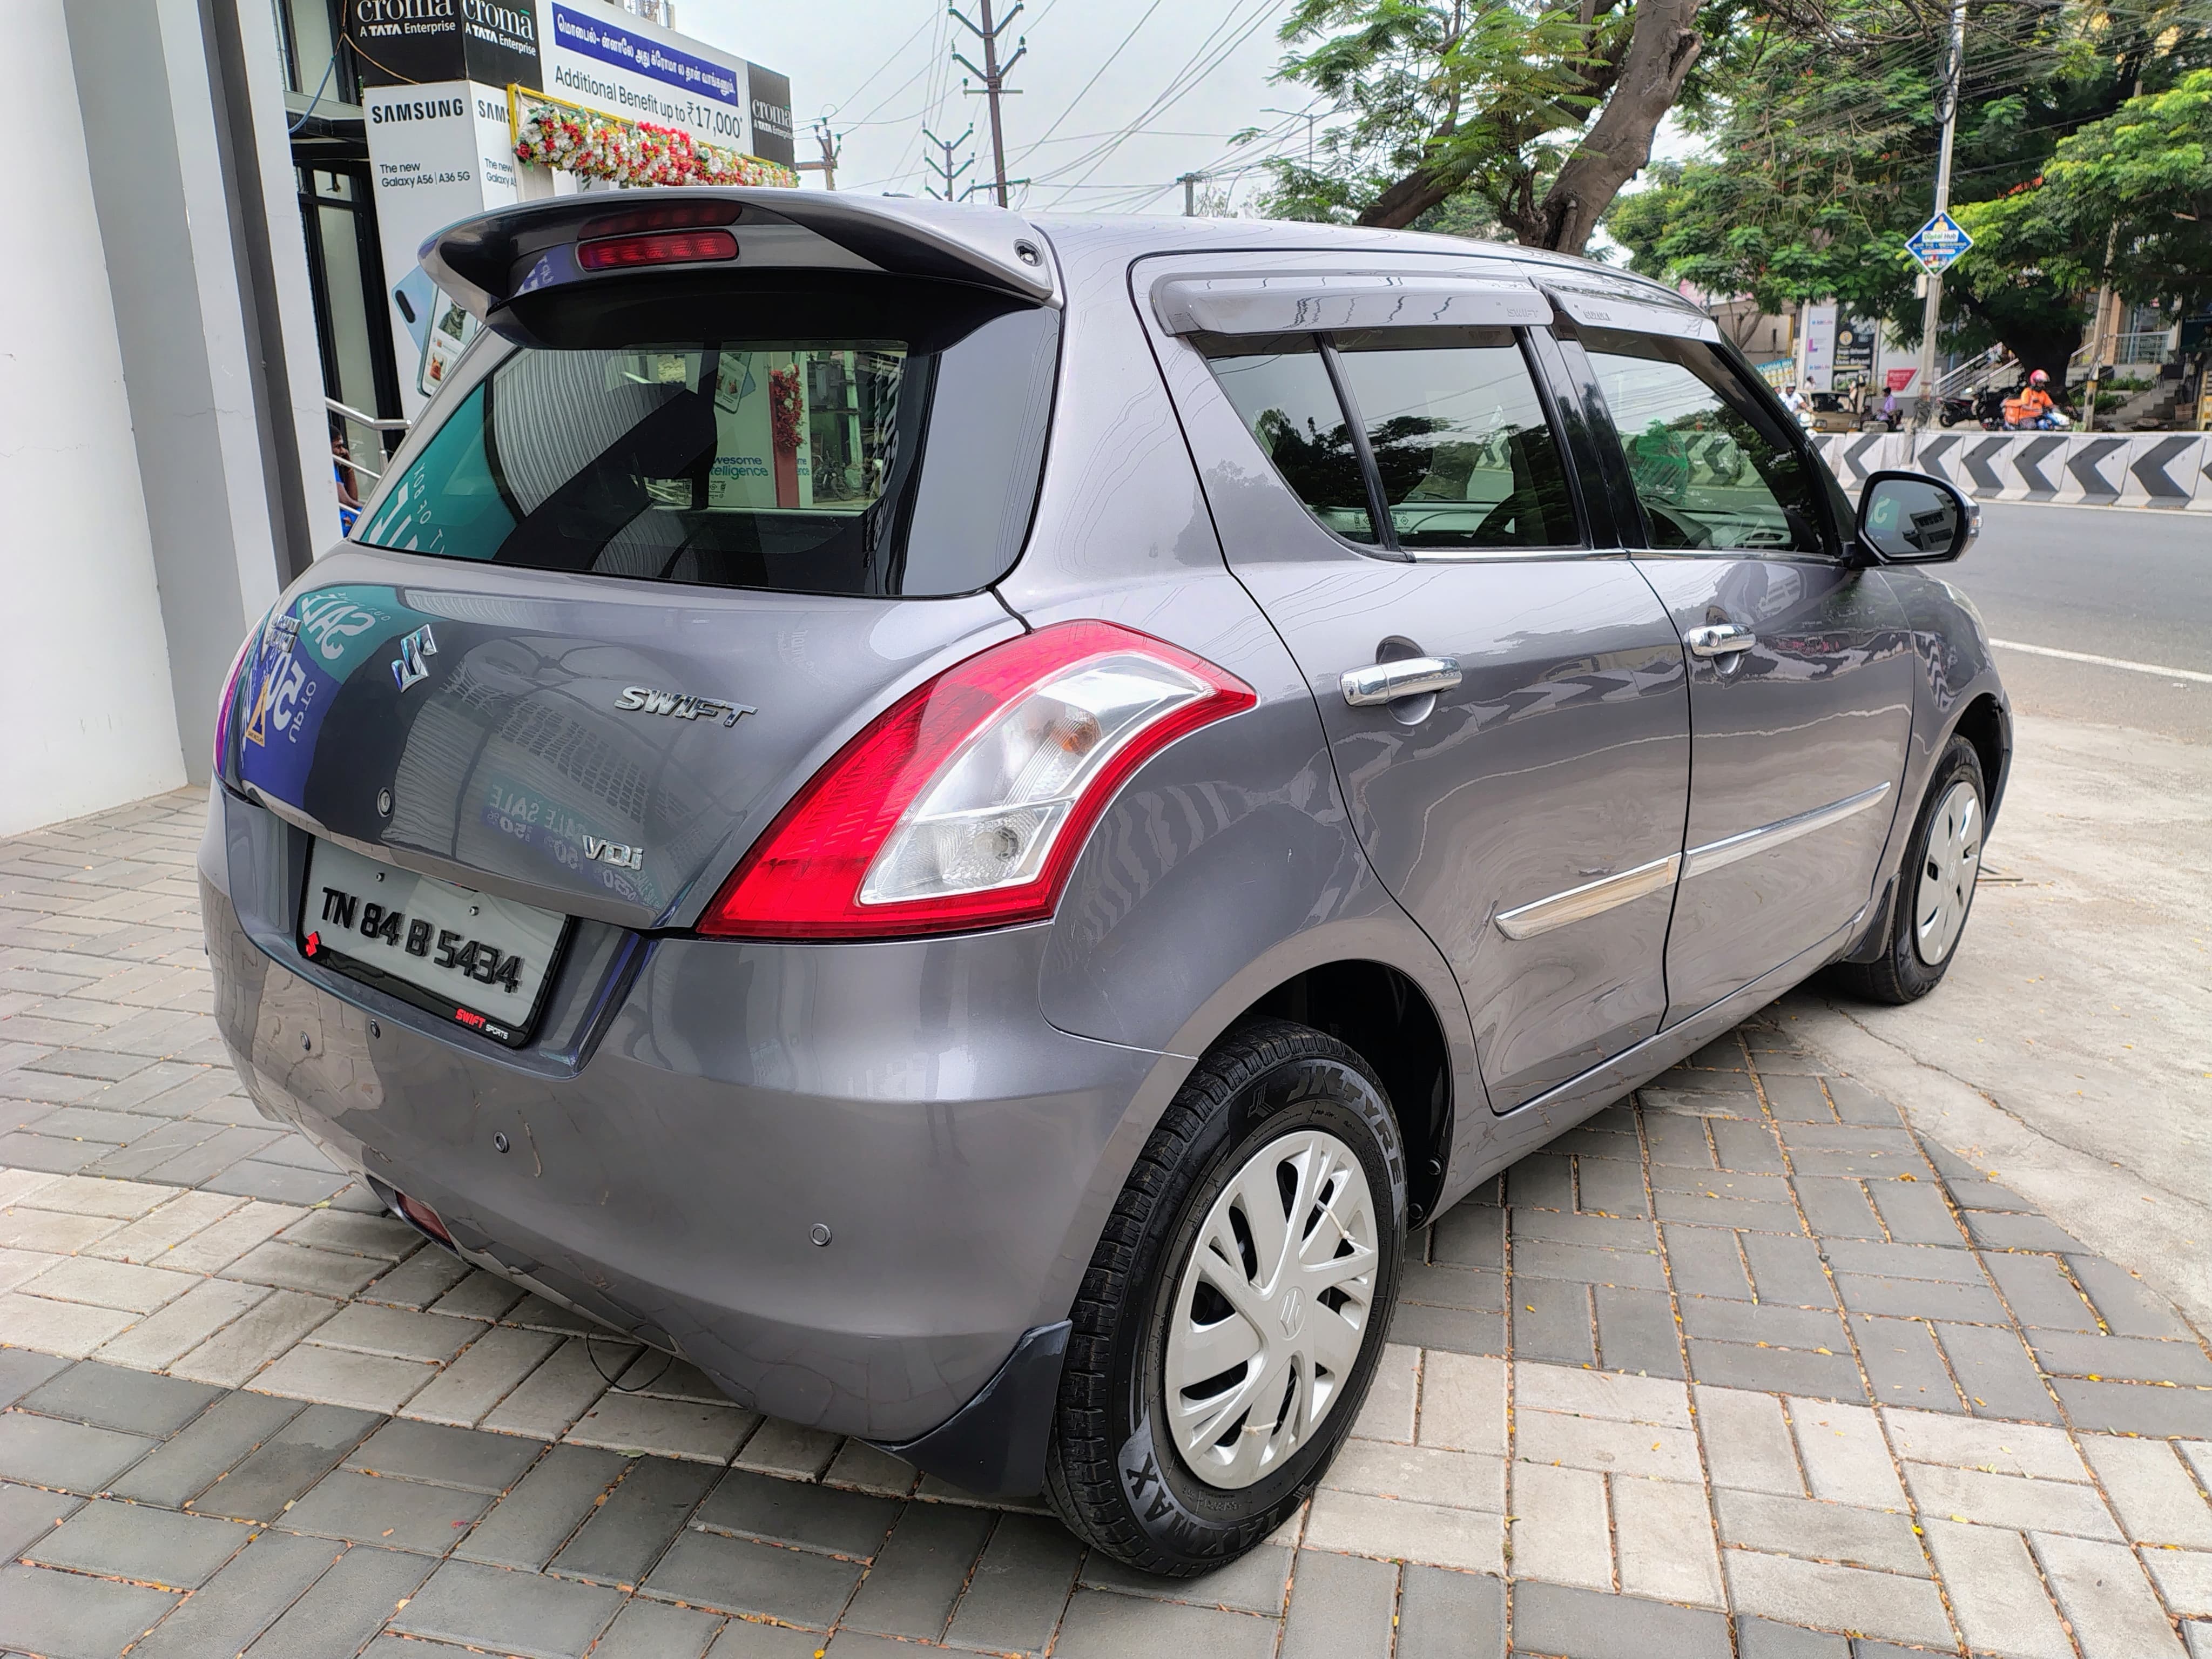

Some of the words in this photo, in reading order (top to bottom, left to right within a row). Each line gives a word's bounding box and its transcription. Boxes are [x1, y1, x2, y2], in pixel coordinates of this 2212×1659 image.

[360, 26, 368, 37] A
[368, 24, 402, 37] TATA
[404, 21, 456, 35] Enterprise
[466, 22, 472, 35] A
[472, 24, 498, 43] TATA
[499, 33, 536, 56] Enterprise
[635, 49, 650, 68] அது
[555, 65, 616, 102] Additional
[619, 86, 658, 114] Benefit
[660, 102, 673, 123] up
[675, 105, 685, 122] to
[372, 98, 464, 124] SAMSUNG
[757, 120, 772, 133] TATA
[380, 164, 397, 174] The
[400, 163, 421, 172] new
[484, 158, 497, 170] The
[498, 161, 512, 172] new
[382, 176, 415, 188] Galaxy
[417, 173, 434, 185] A56
[439, 171, 455, 183] A36
[457, 171, 471, 181] 5G
[486, 171, 510, 188] Galaxy
[1507, 308, 1539, 318] SWIFT
[1583, 311, 1612, 321] SUZUKI
[613, 685, 758, 727] SWIFT
[582, 835, 644, 871] VDi
[321, 887, 356, 929] TN
[360, 902, 404, 946] 84
[404, 919, 431, 957] B
[434, 929, 524, 994] 5434
[455, 1008, 485, 1029] SWIFT
[485, 1024, 509, 1040] SPORTS
